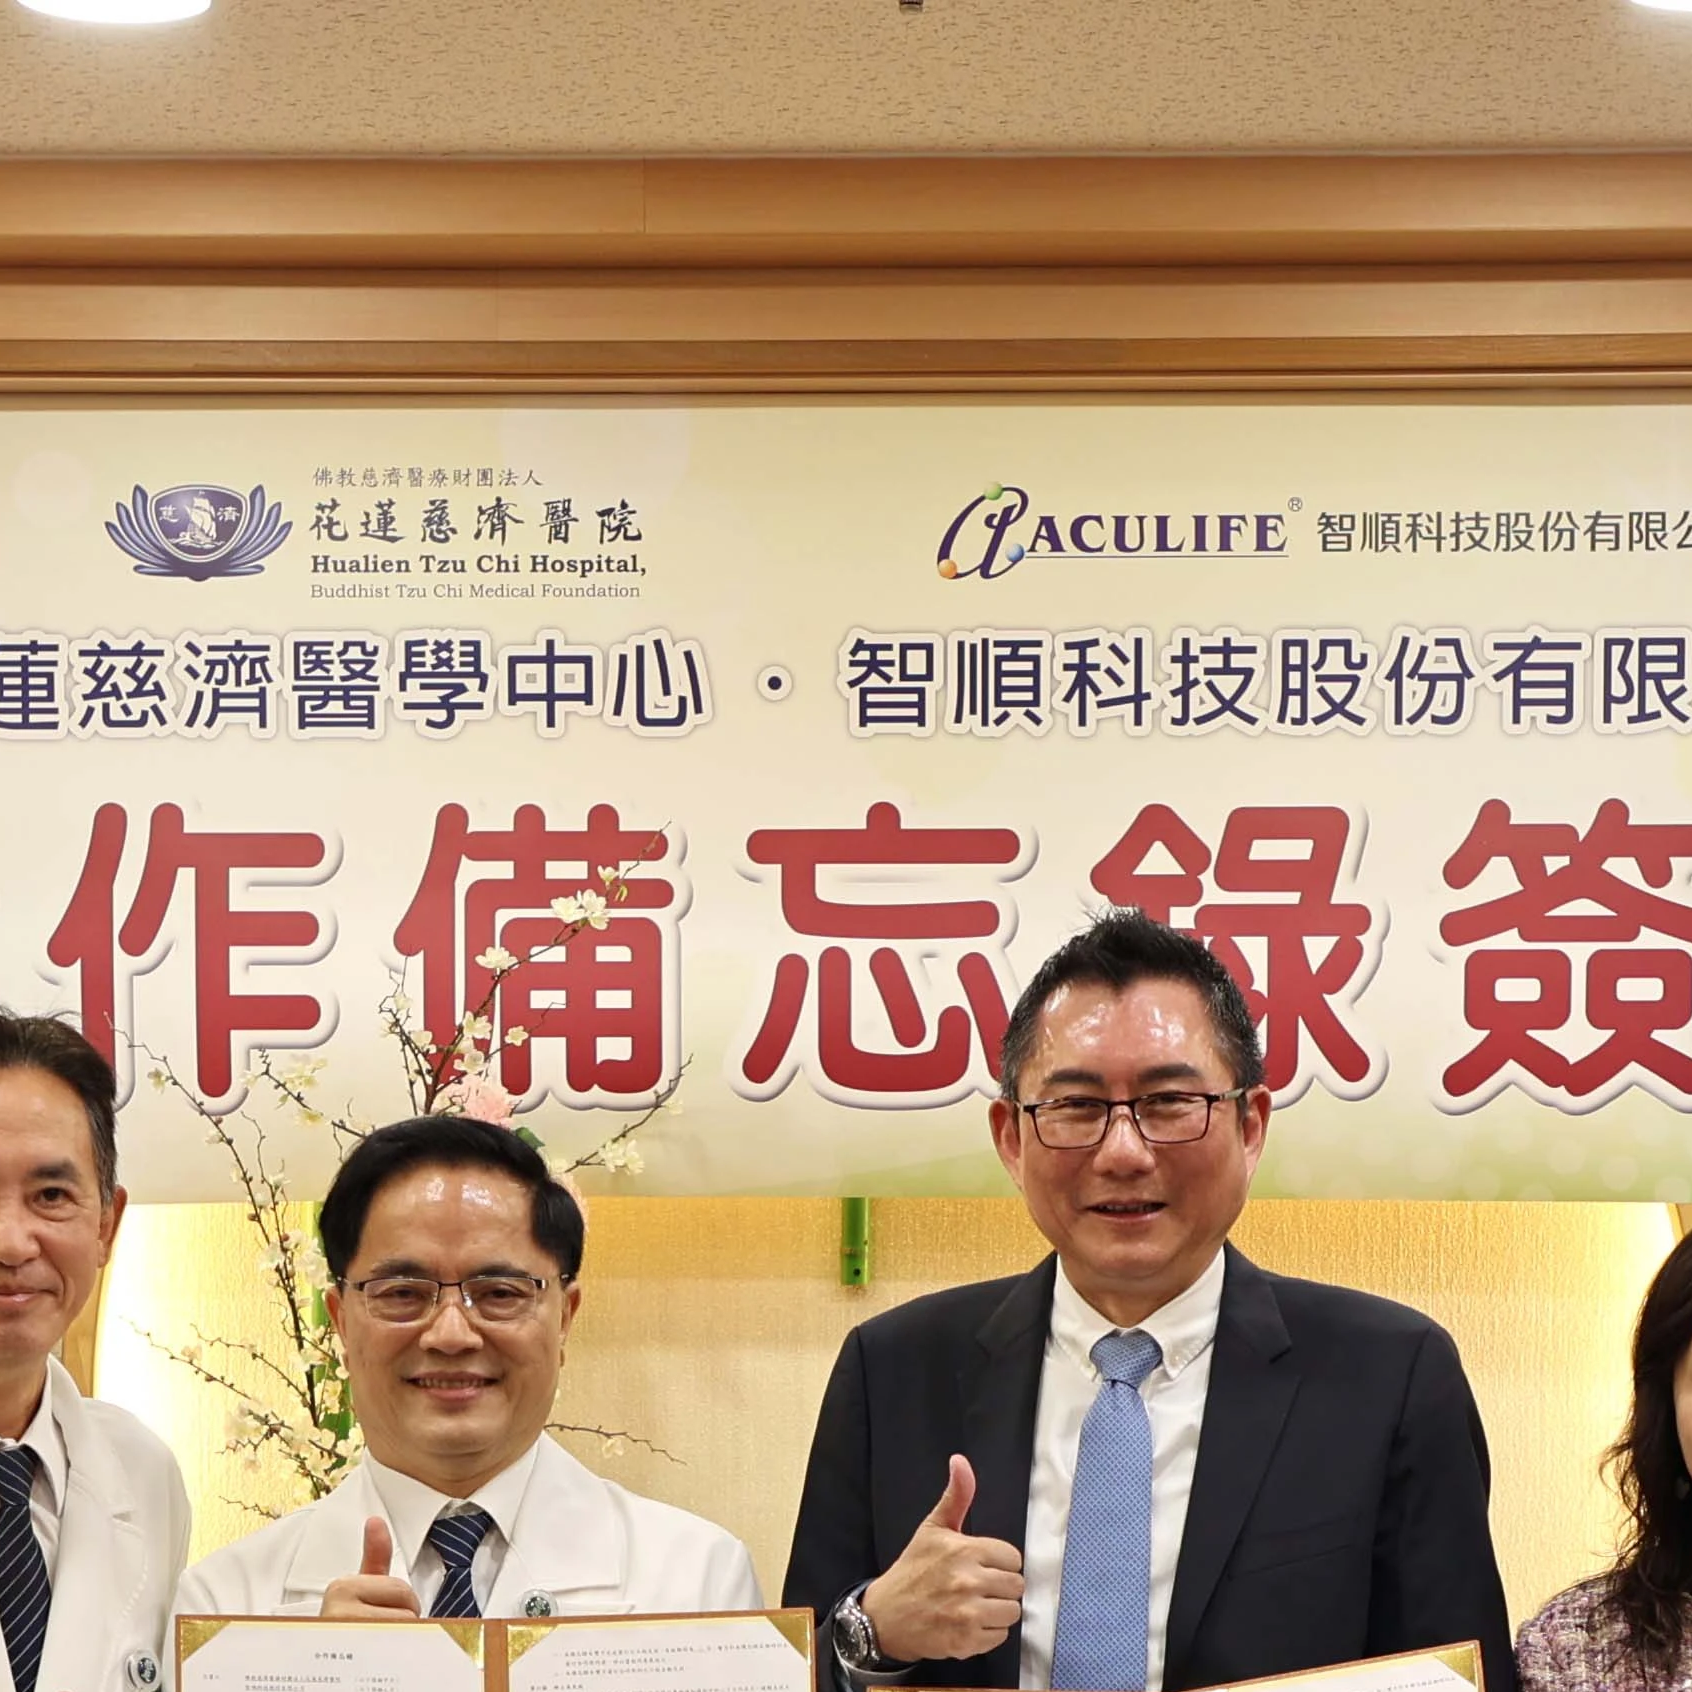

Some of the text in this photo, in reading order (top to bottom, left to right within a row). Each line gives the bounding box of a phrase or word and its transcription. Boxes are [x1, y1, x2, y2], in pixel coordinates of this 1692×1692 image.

[313, 466, 543, 489] 佛教慈濟醫療財團法人
[309, 496, 644, 546] 花蓮慈濟醫院
[311, 554, 646, 579] Hualien Tzu Chi Hospital,
[311, 583, 640, 599] Buddhist Tzu Chi Medical Foundation
